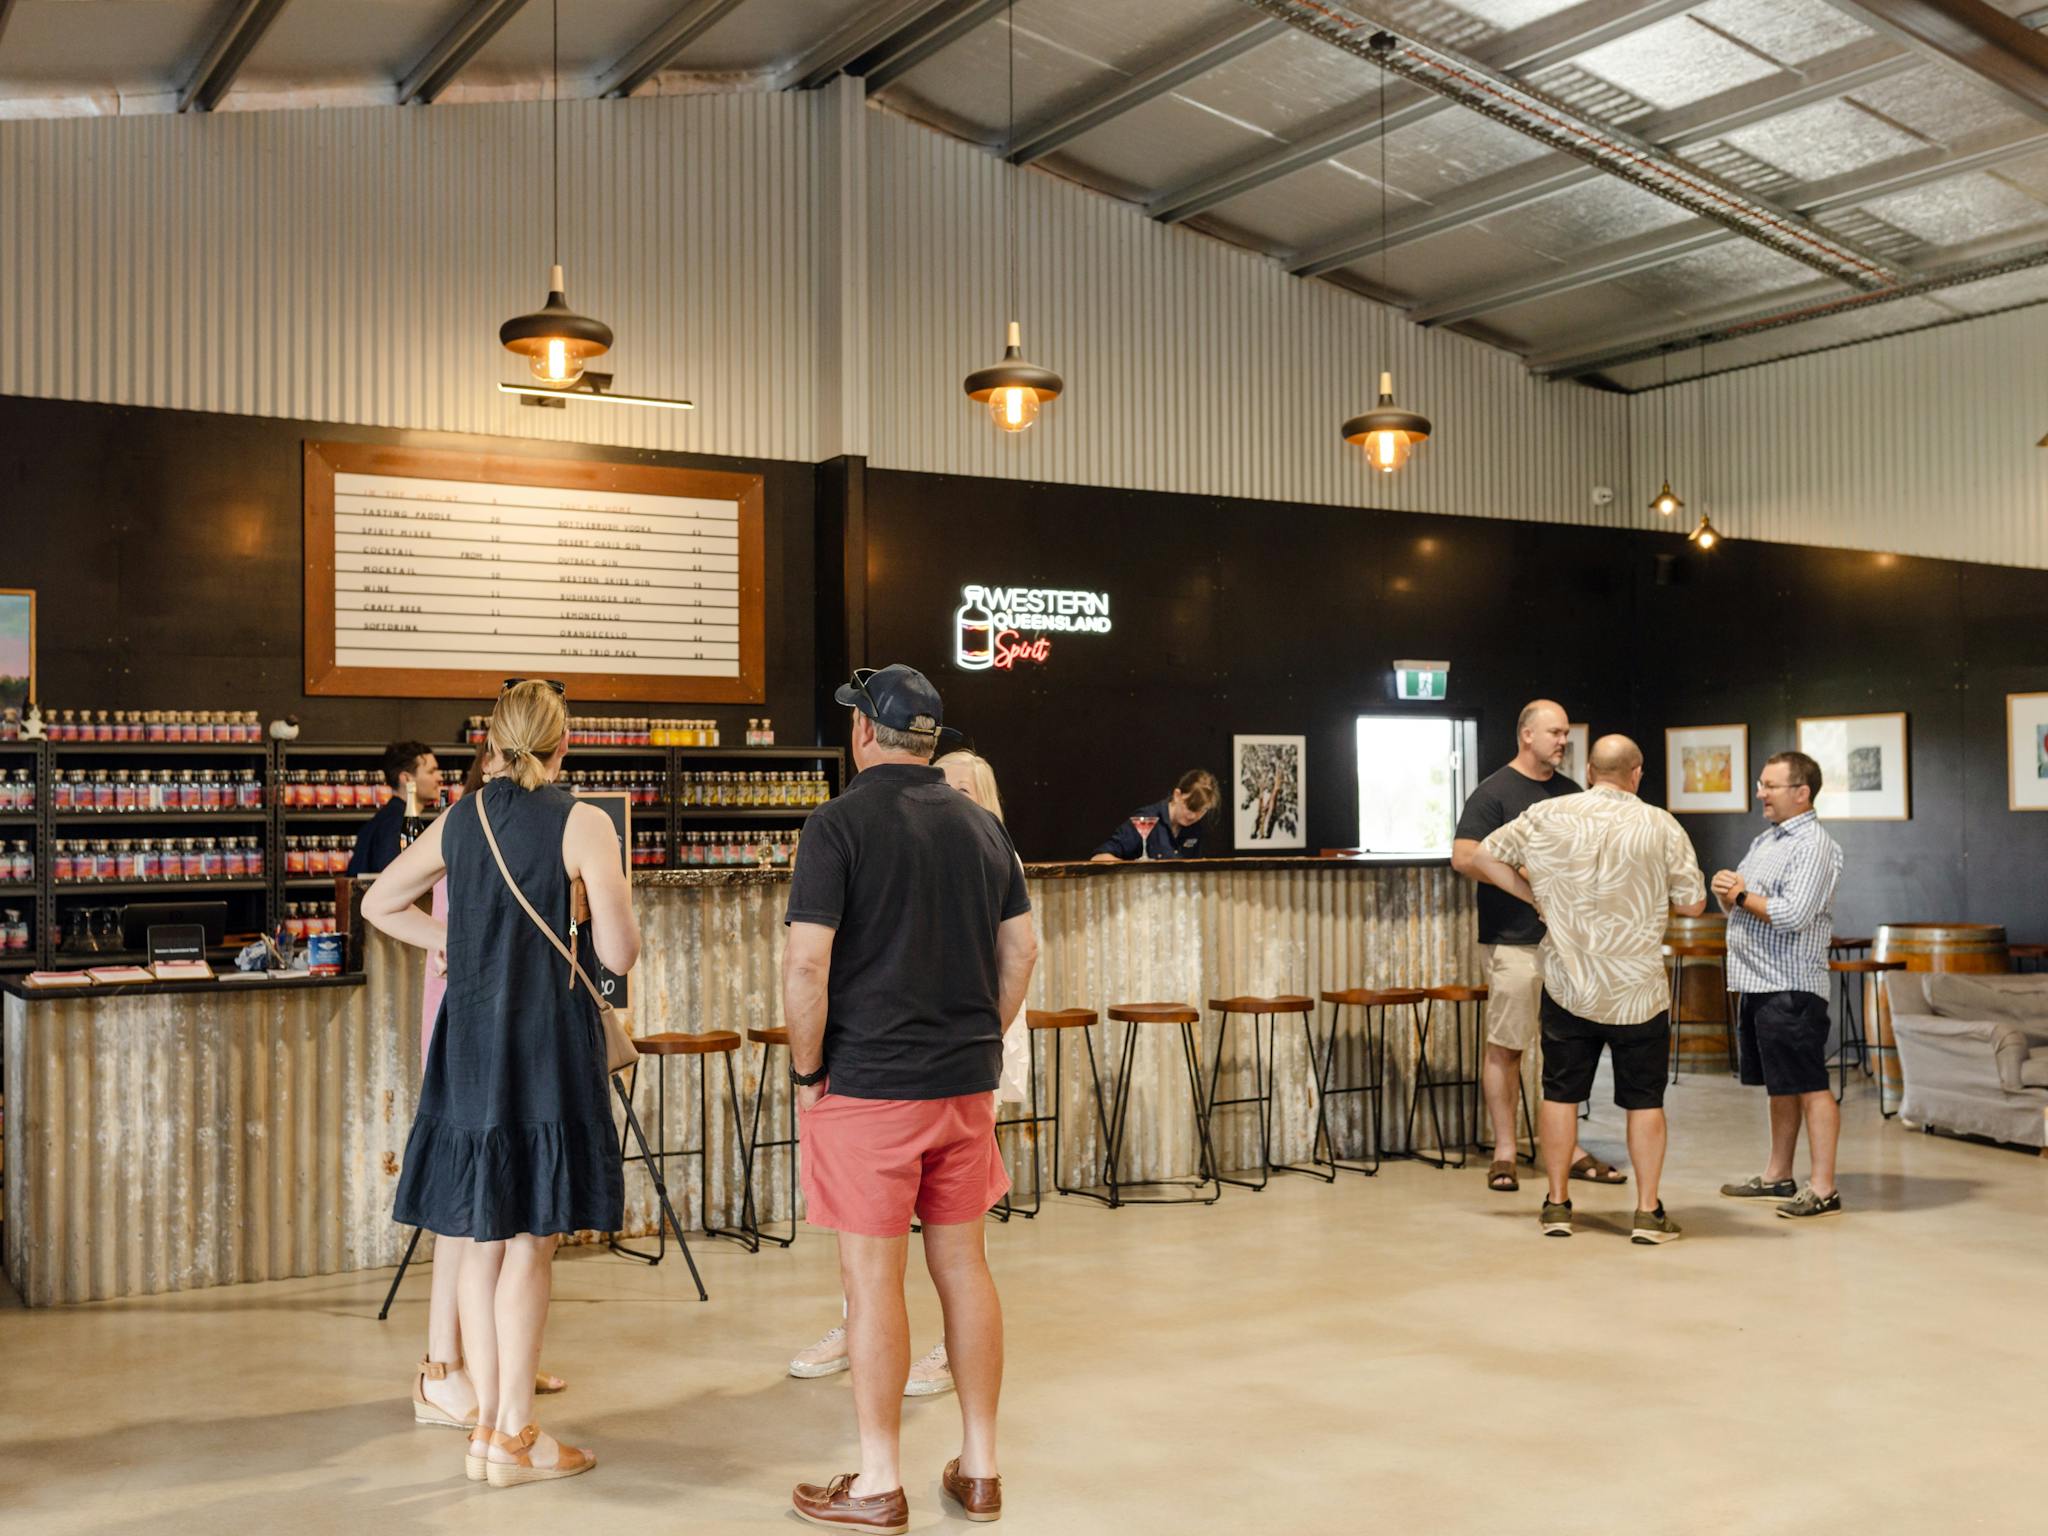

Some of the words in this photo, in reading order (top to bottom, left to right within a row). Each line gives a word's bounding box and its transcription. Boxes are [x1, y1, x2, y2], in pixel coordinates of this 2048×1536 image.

[362, 508, 408, 518] TASTING
[416, 512, 452, 520] PADDLE
[362, 527, 394, 536] SPIRIT
[558, 520, 618, 532] BOTTLEBRUSH
[624, 525, 652, 533] VODKA
[558, 538, 590, 548] DESERT
[594, 540, 620, 549] OASIS
[625, 542, 641, 550] GIN
[362, 546, 415, 557] COCKTAIL
[460, 552, 482, 560] FROM
[558, 557, 596, 566] OUTBACK
[602, 560, 619, 568] GIN
[363, 566, 416, 576] MOCKTAIL
[560, 576, 599, 584] WESTERN
[605, 578, 629, 586] SKIES
[634, 579, 650, 587] GIN
[363, 585, 389, 593] WINE
[560, 594, 618, 604] BUSHRANGER
[624, 596, 642, 605] RUM
[984, 588, 1108, 615] WESTERN
[363, 604, 394, 612] CRAFT
[400, 606, 422, 614] BEER
[560, 612, 621, 622] LEMONCELLO
[994, 611, 1112, 633] QUEENSLAND
[364, 622, 419, 632] SOFTDRINK
[560, 630, 628, 640] ORANGECELLO
[560, 648, 583, 656] MINI
[589, 649, 610, 658] TRIO
[615, 650, 637, 658] PACK
[994, 630, 1050, 668] Spirit
